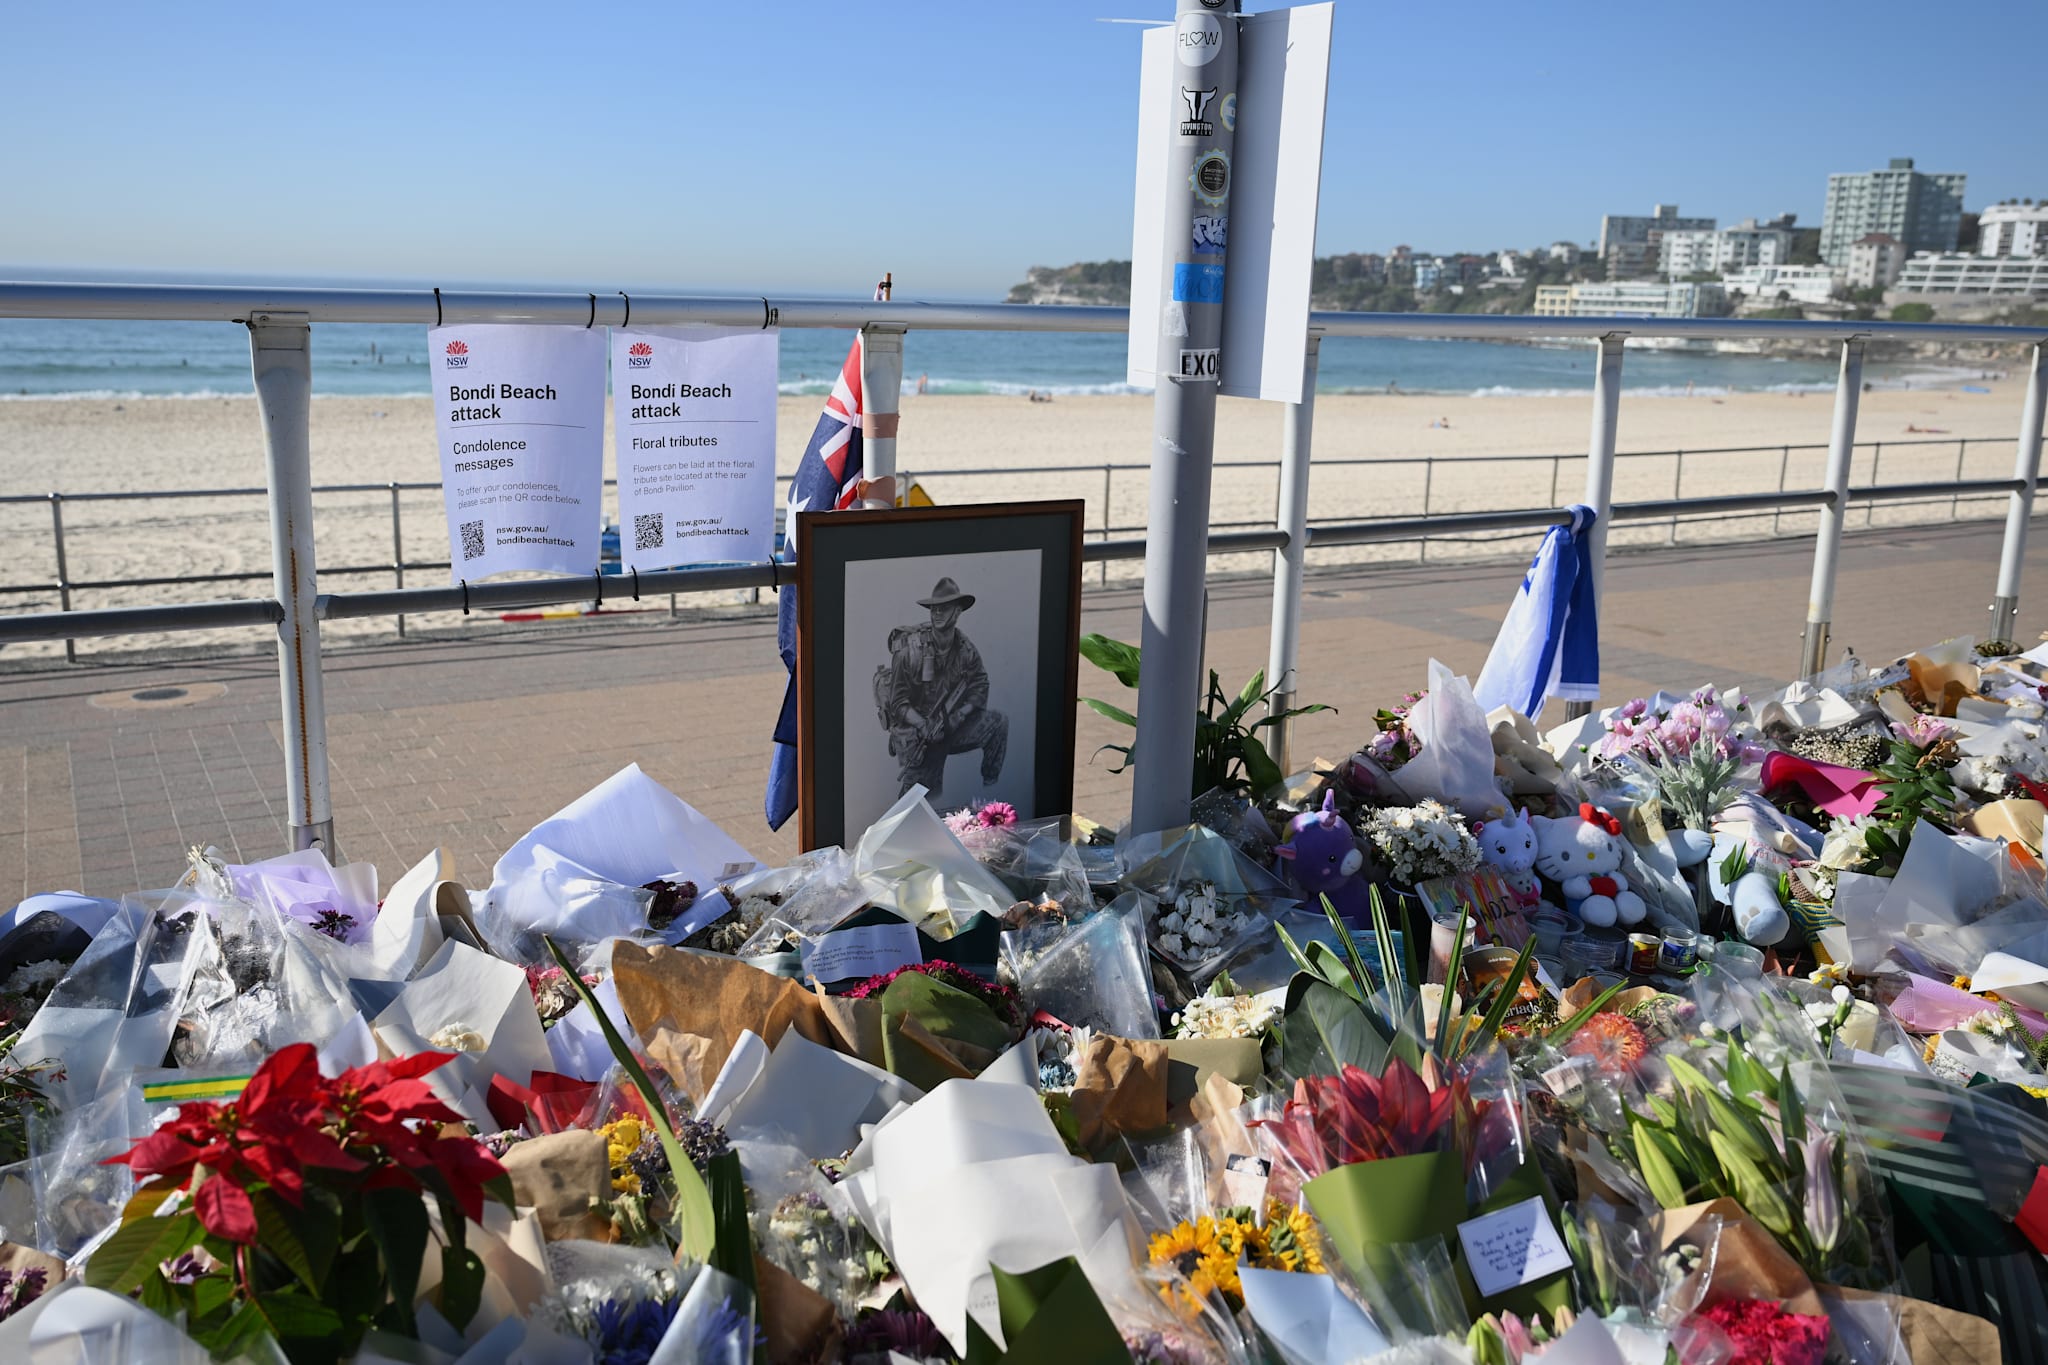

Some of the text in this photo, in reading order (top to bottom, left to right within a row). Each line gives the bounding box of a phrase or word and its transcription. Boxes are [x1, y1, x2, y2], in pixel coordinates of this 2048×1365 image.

[446, 356, 468, 366] NSW
[628, 357, 652, 366] NSW
[450, 384, 557, 401] Bondi Beach
[631, 383, 732, 399] Bondi Beach
[451, 403, 502, 421] attack
[631, 402, 681, 419] attack
[453, 439, 527, 455] Condolence
[632, 435, 718, 450] Floral tributes
[455, 458, 514, 473] messages
[633, 460, 755, 473] Flowers can be laid at the floral
[634, 475, 658, 485] tribute
[659, 473, 672, 482] site
[674, 471, 703, 480] located
[704, 471, 714, 480] at
[715, 471, 729, 479] the
[457, 482, 561, 496] To offer your condolences,
[634, 487, 642, 496] of
[643, 485, 664, 495] Bondi
[458, 493, 582, 510] please scan the QR code below.
[676, 517, 723, 527] nsw.gov.au/
[496, 525, 549, 534] nsw.gov.au/
[676, 528, 749, 538] bondibeachattack
[496, 536, 576, 547] bondibeachattack
